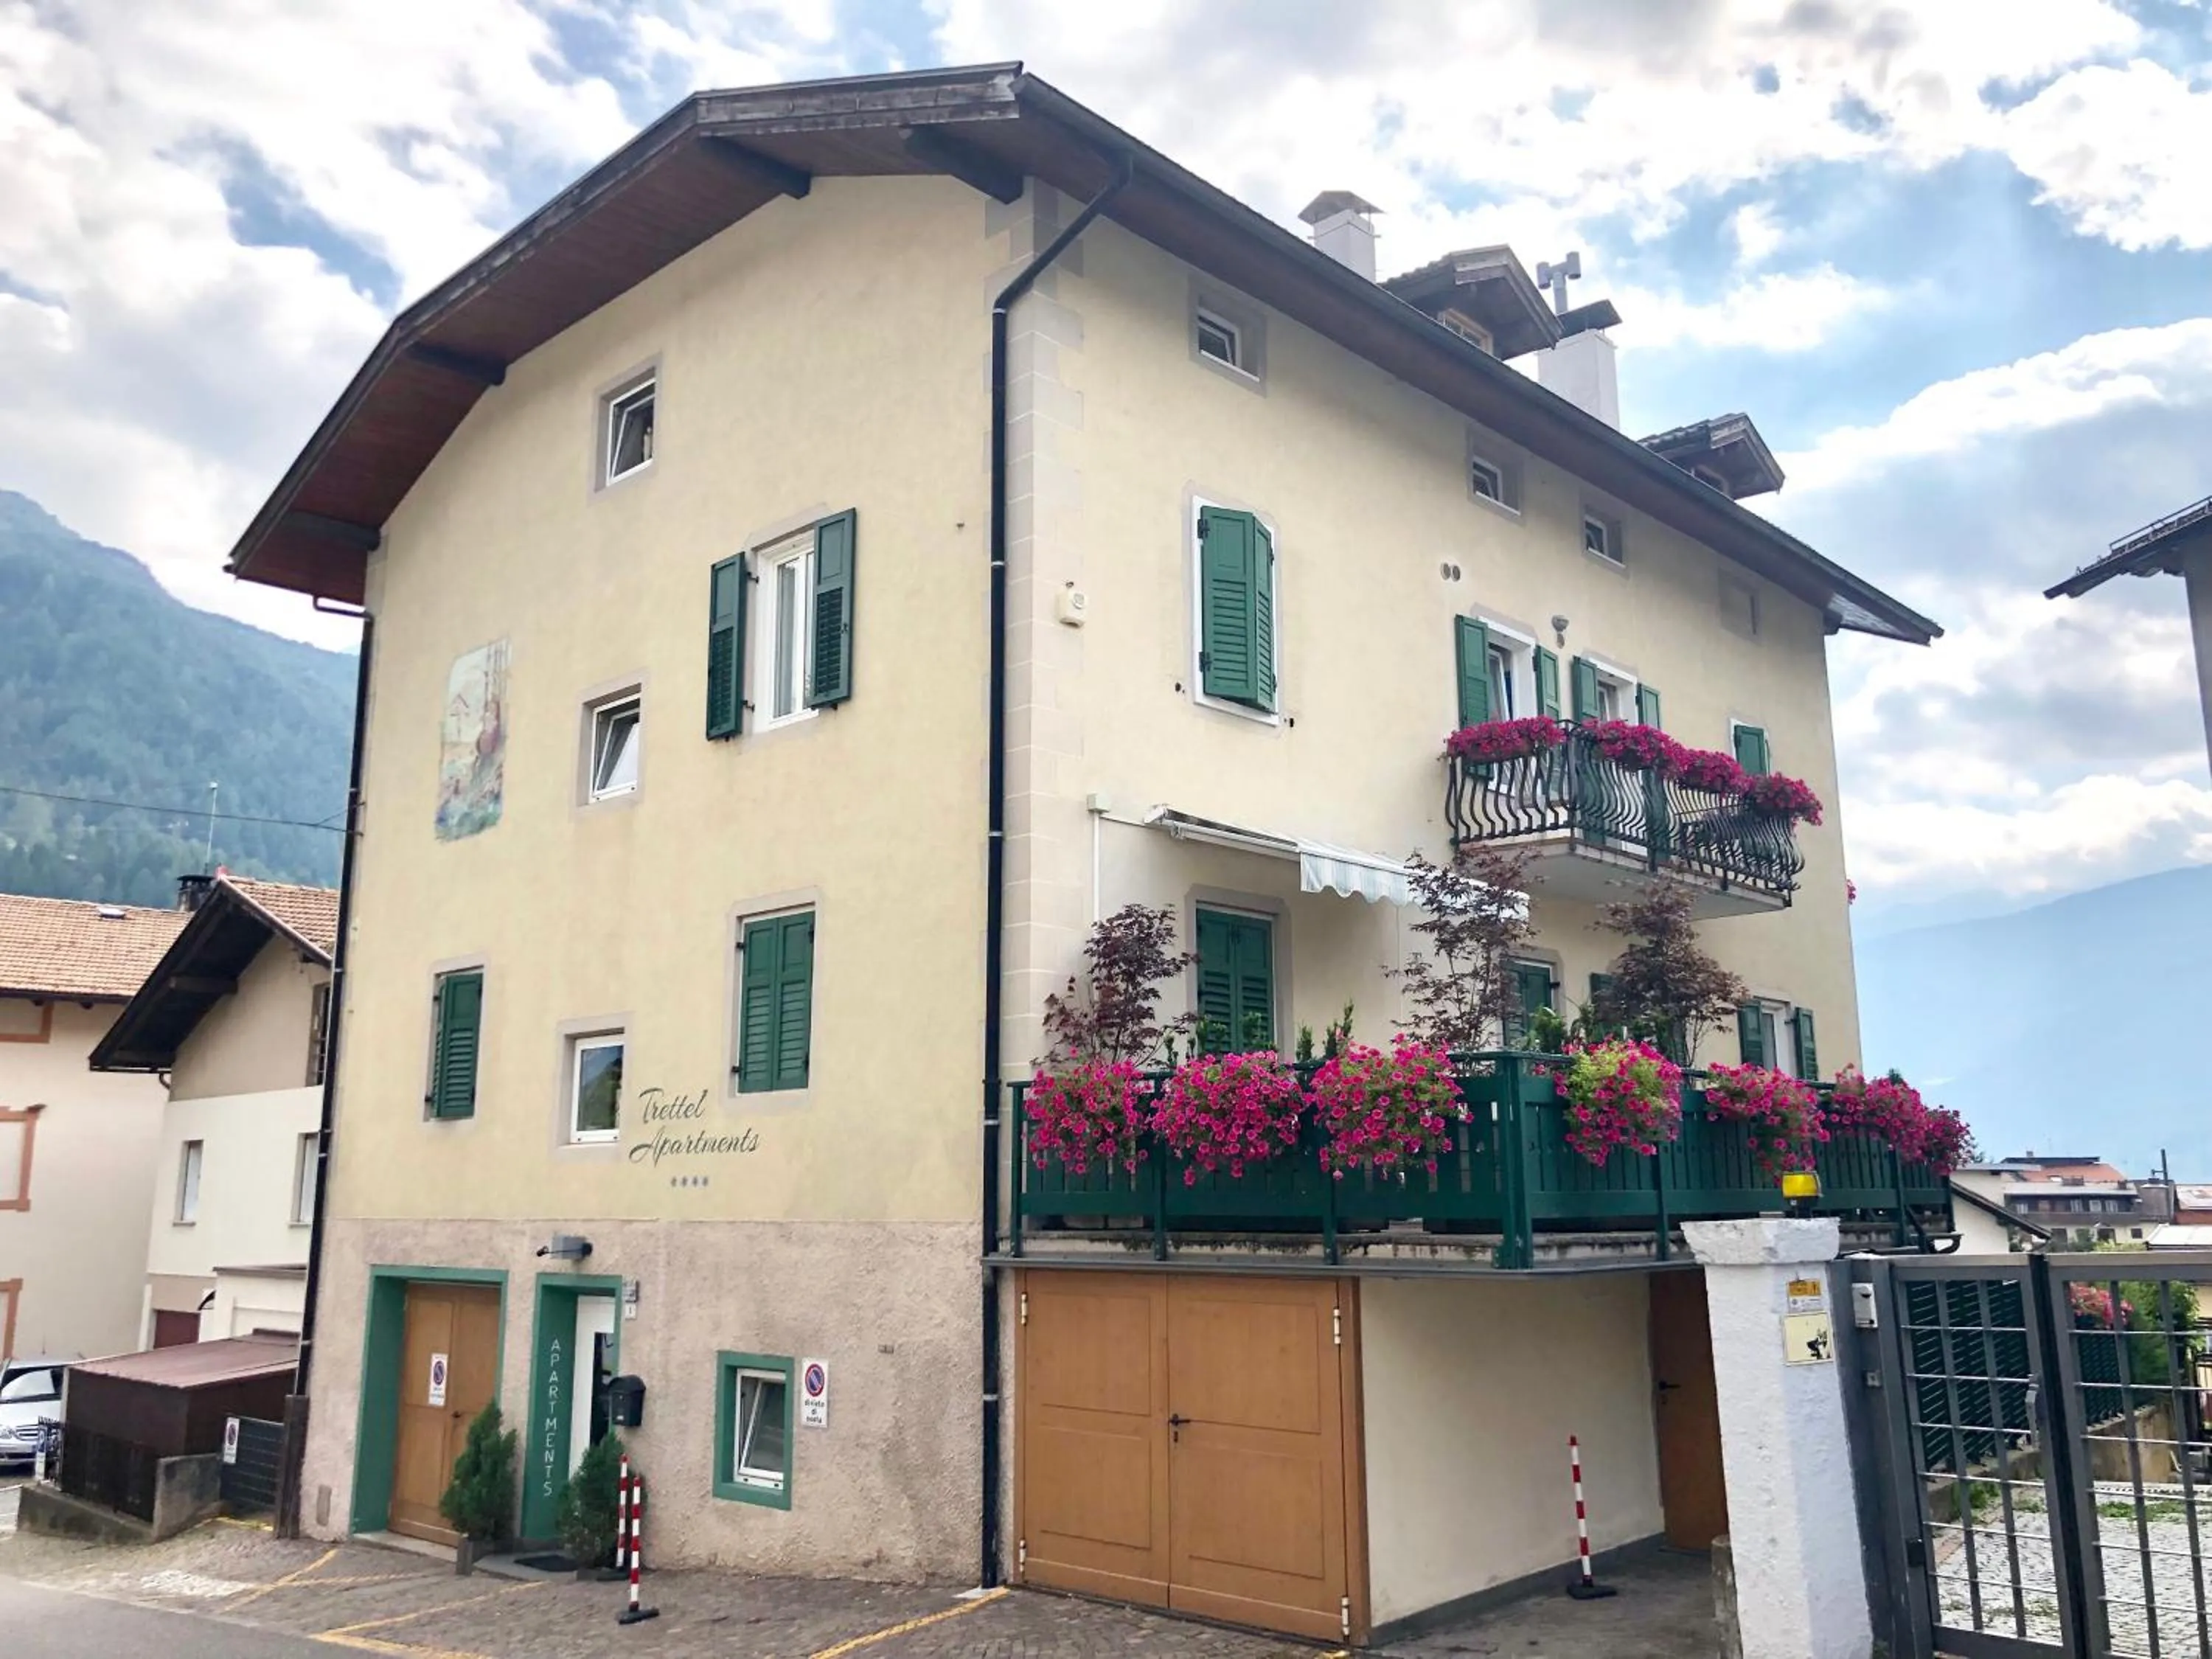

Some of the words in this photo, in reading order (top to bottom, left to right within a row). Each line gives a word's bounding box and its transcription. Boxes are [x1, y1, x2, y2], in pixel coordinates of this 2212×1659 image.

[639, 1088, 708, 1124] Trettel
[629, 1126, 759, 1167] Apartments
[543, 1338, 561, 1497] APARTMENTS
